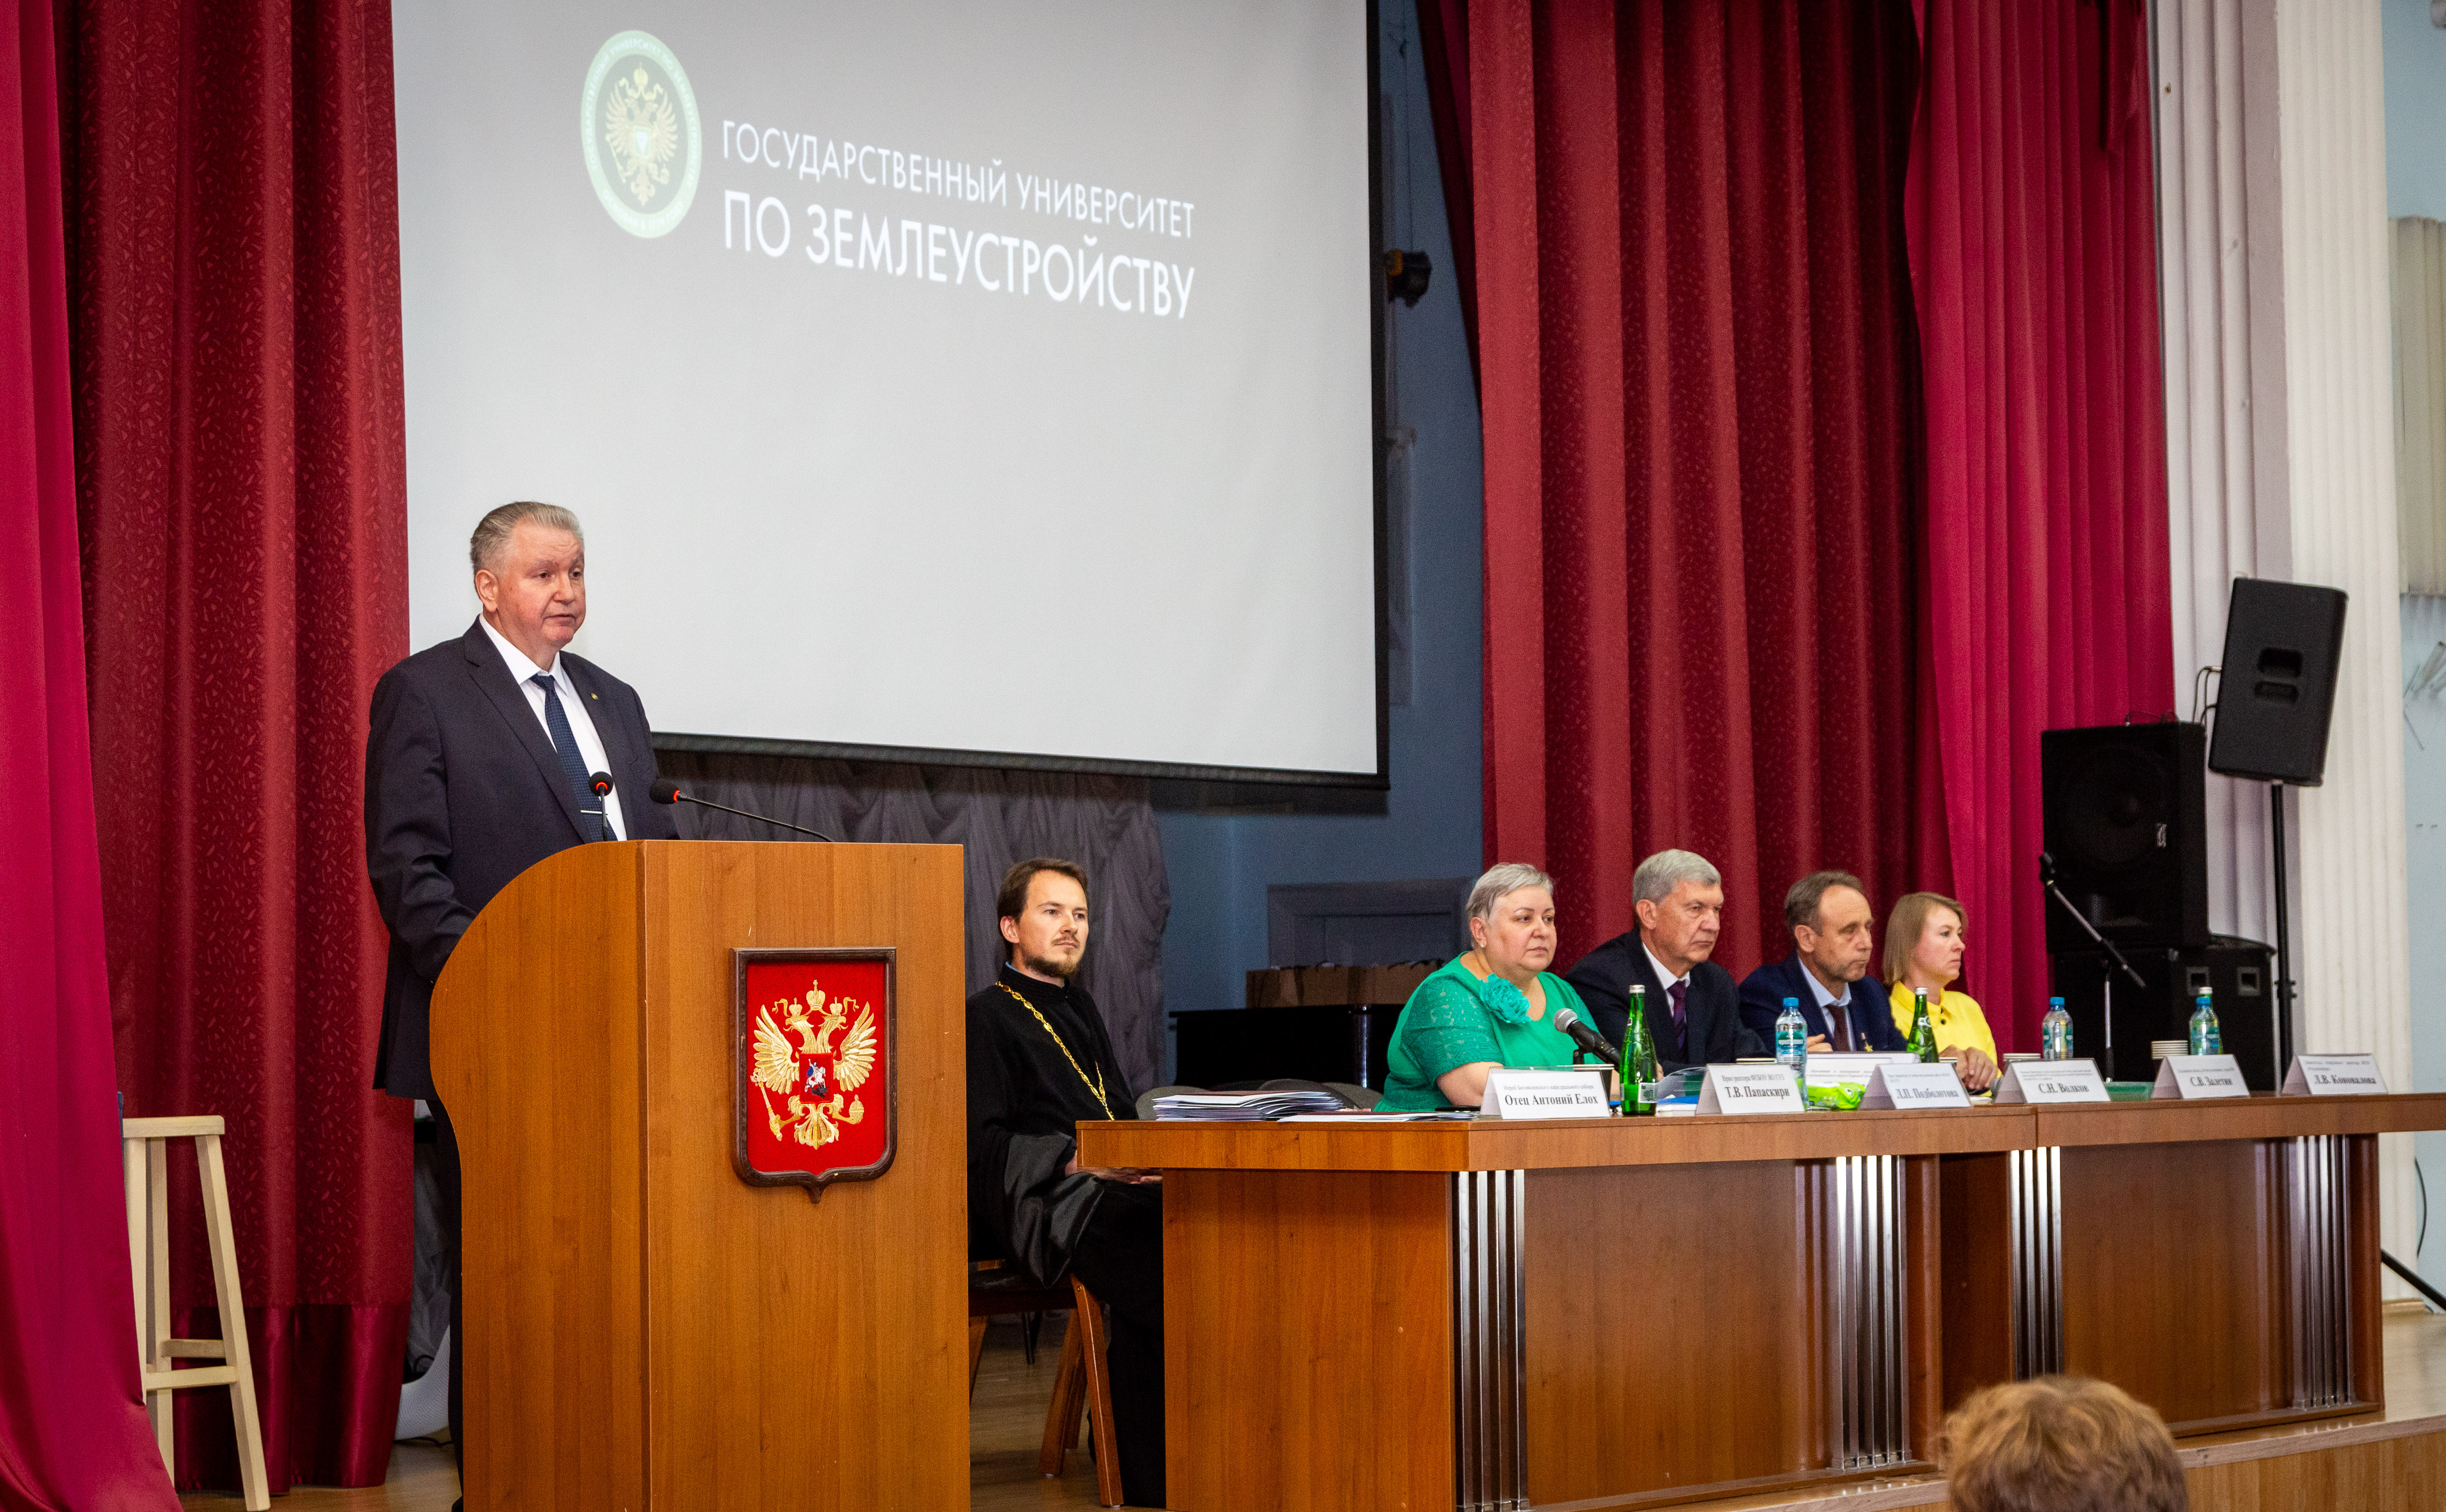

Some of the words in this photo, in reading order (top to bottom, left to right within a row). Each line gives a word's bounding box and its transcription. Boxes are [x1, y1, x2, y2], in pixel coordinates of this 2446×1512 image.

[723, 120, 1007, 207] ГОСУДАРСТВЕННЫЙ
[1016, 173, 1195, 239] УНИВЕРСИТЕТ
[724, 190, 791, 258] ПО
[806, 204, 1195, 319] ЗЕМЛЕУСТРОЙСТВУ
[2038, 1083, 2058, 1093] С.Н.
[2057, 1083, 2090, 1093] Волков
[2190, 1077, 2206, 1086] С.В.
[1725, 1086, 1743, 1097] Т.В.
[1744, 1086, 1790, 1099] Папаскири
[1505, 1095, 1530, 1106] Отец
[1533, 1094, 1573, 1105] Антоний
[1575, 1093, 1599, 1105] Елох
